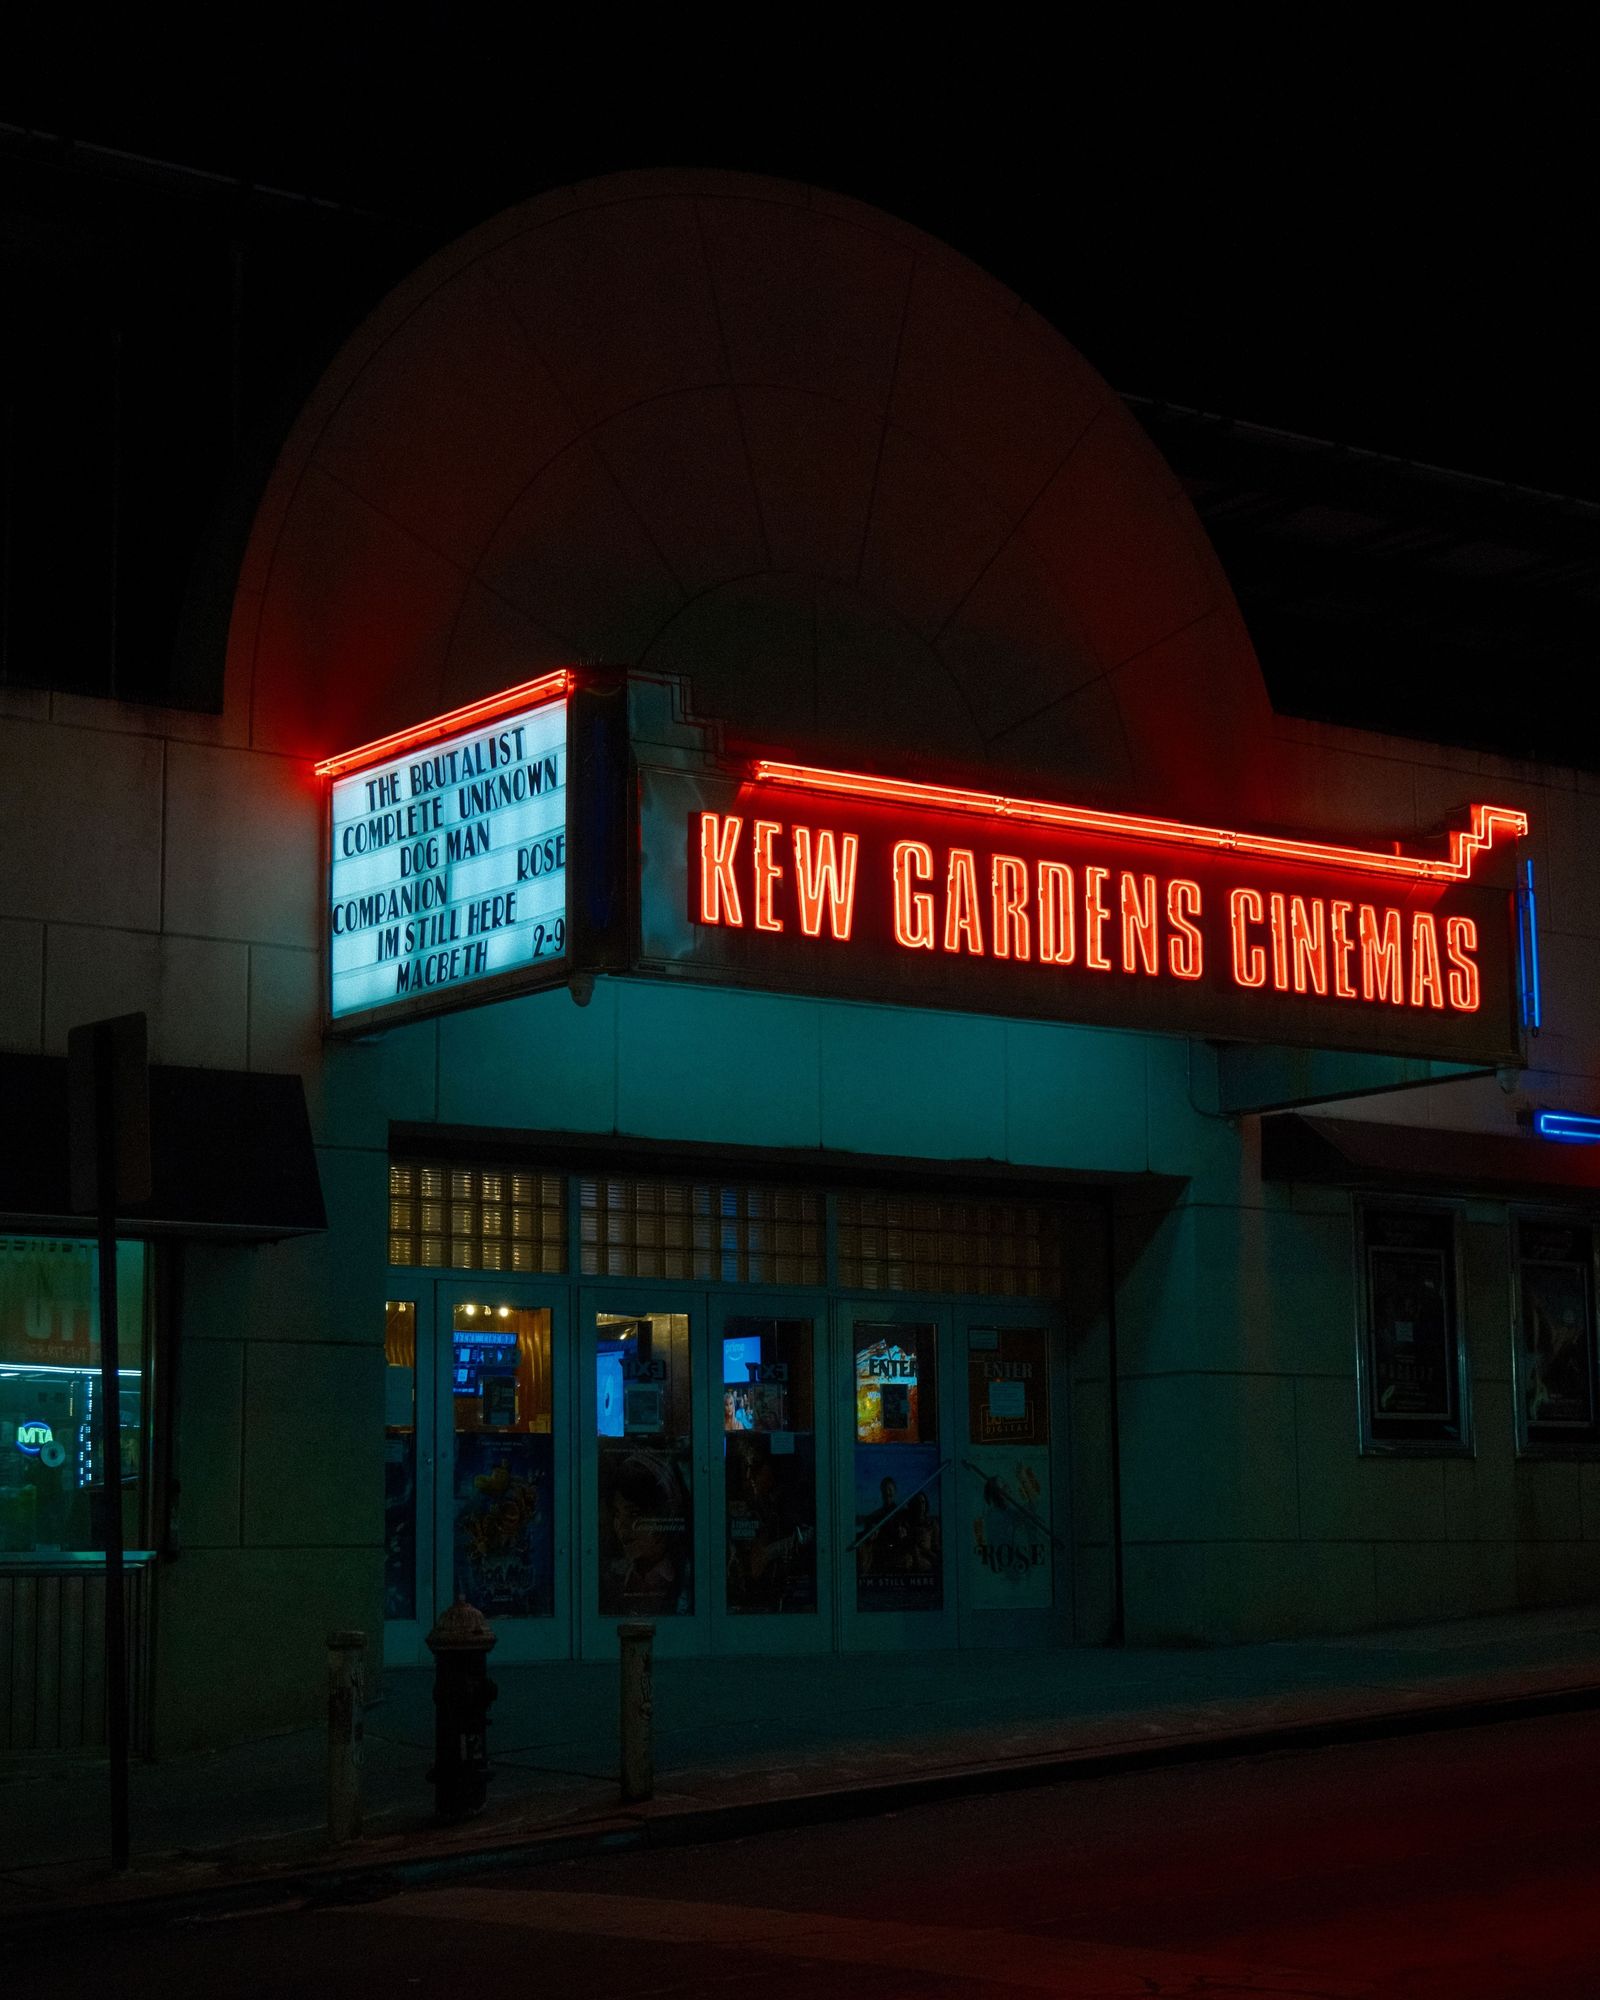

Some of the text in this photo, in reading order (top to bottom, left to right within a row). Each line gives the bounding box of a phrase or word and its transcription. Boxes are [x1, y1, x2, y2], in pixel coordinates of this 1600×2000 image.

[366, 727, 525, 812] THE BRUTALIST
[343, 754, 557, 857] COMPLETE UNKNOWN
[401, 820, 490, 878] DOG MAN
[517, 834, 565, 881] ROSE
[333, 874, 447, 934] COMPANION
[378, 891, 516, 962] IM STILL HERE
[700, 812, 1480, 1012] KEW GARDENS CINEMAS
[533, 918, 565, 958] 2-9
[396, 941, 488, 994] MACBETH
[984, 1360, 1032, 1379] ENTER
[17, 1427, 53, 1444] MTA
[974, 1544, 1045, 1574] ROSE
